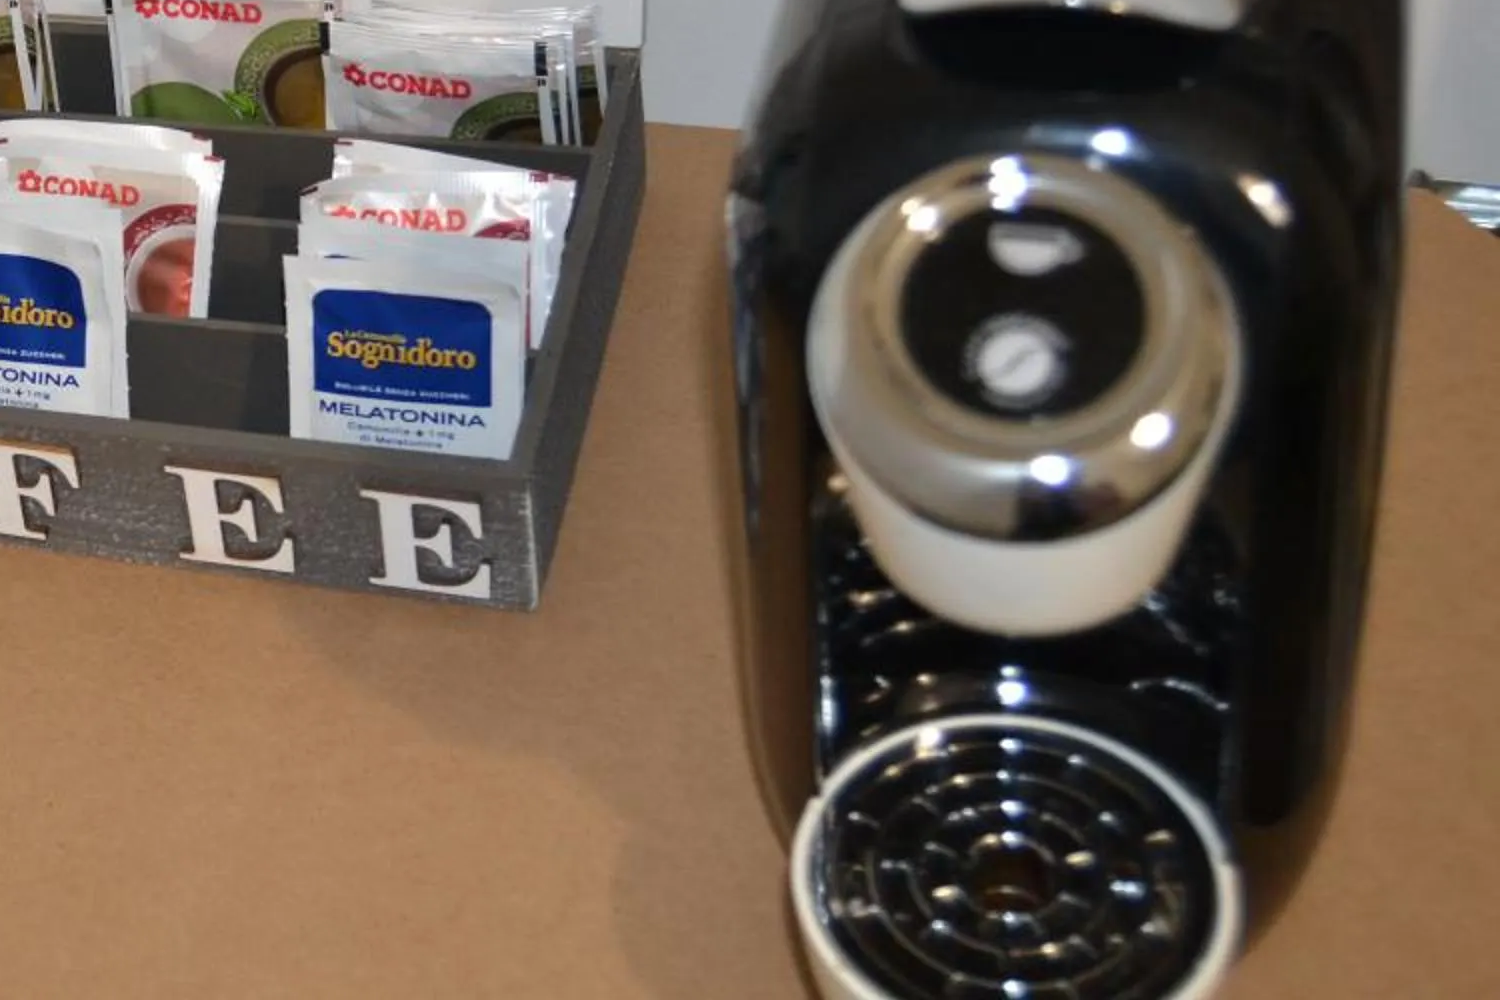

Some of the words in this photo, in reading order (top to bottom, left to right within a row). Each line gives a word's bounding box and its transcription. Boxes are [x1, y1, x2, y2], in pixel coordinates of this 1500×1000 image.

[369, 71, 472, 100] CONAD
[43, 175, 141, 206] CONAD
[319, 399, 486, 428] MELATONINA
